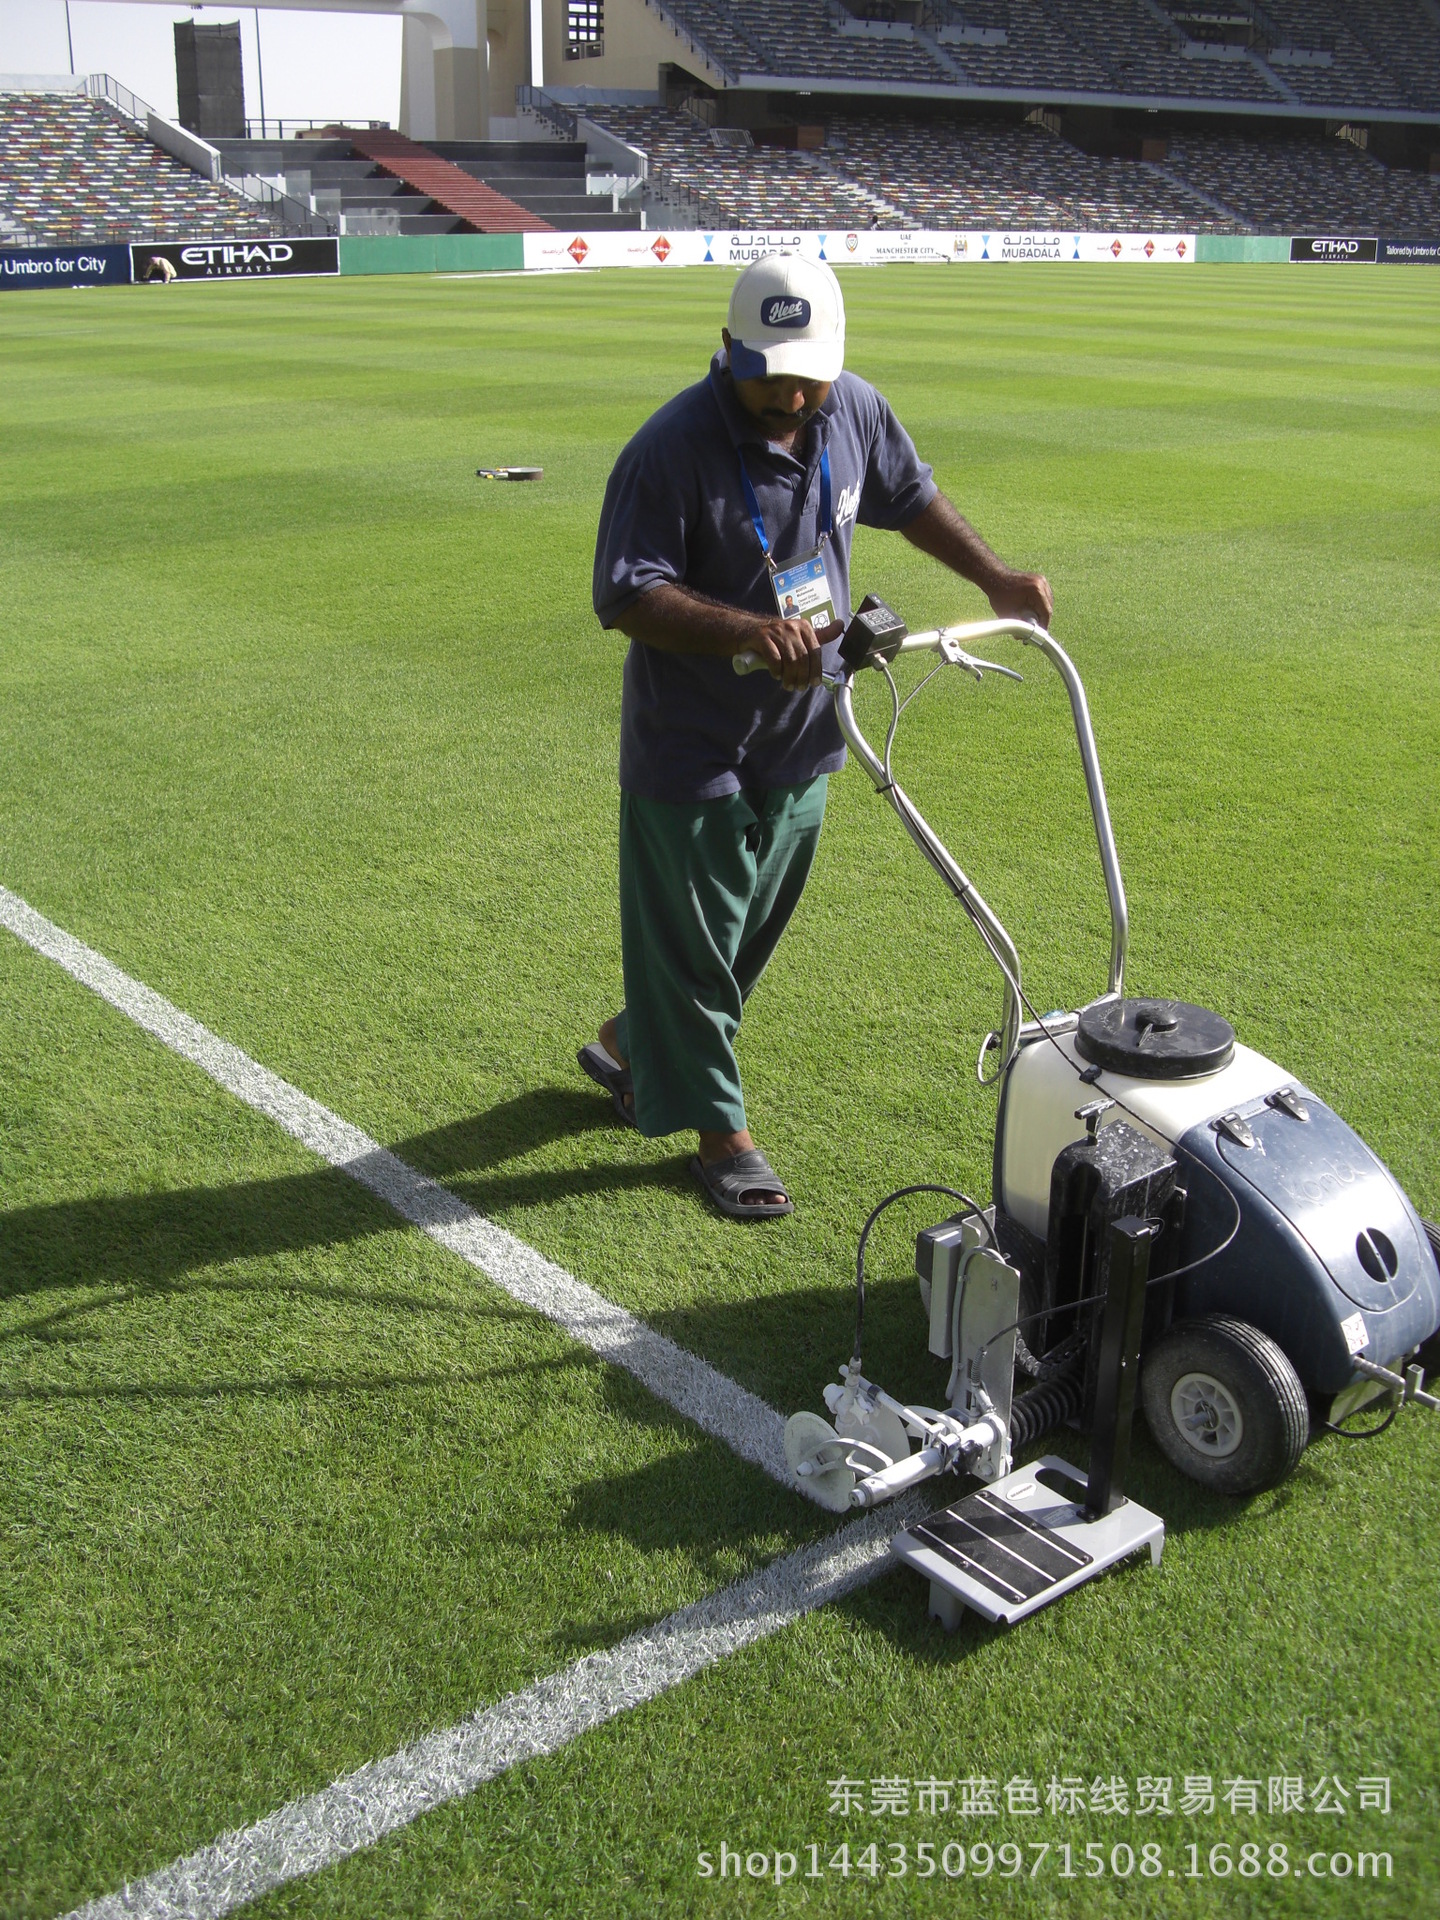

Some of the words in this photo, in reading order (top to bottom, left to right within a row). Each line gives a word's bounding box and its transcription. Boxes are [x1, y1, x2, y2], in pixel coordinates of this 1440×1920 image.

[730, 234, 801, 247] مبادلة
[1311, 240, 1359, 253] ETIHAD
[181, 244, 294, 265] ETIHAD
[1002, 248, 1061, 258] MUBADALA
[1412, 246, 1430, 256] Umbro
[4, 259, 54, 275] Umbro
[55, 257, 75, 272] for
[77, 256, 107, 275] City
[206, 264, 272, 275] AIRWAYS
